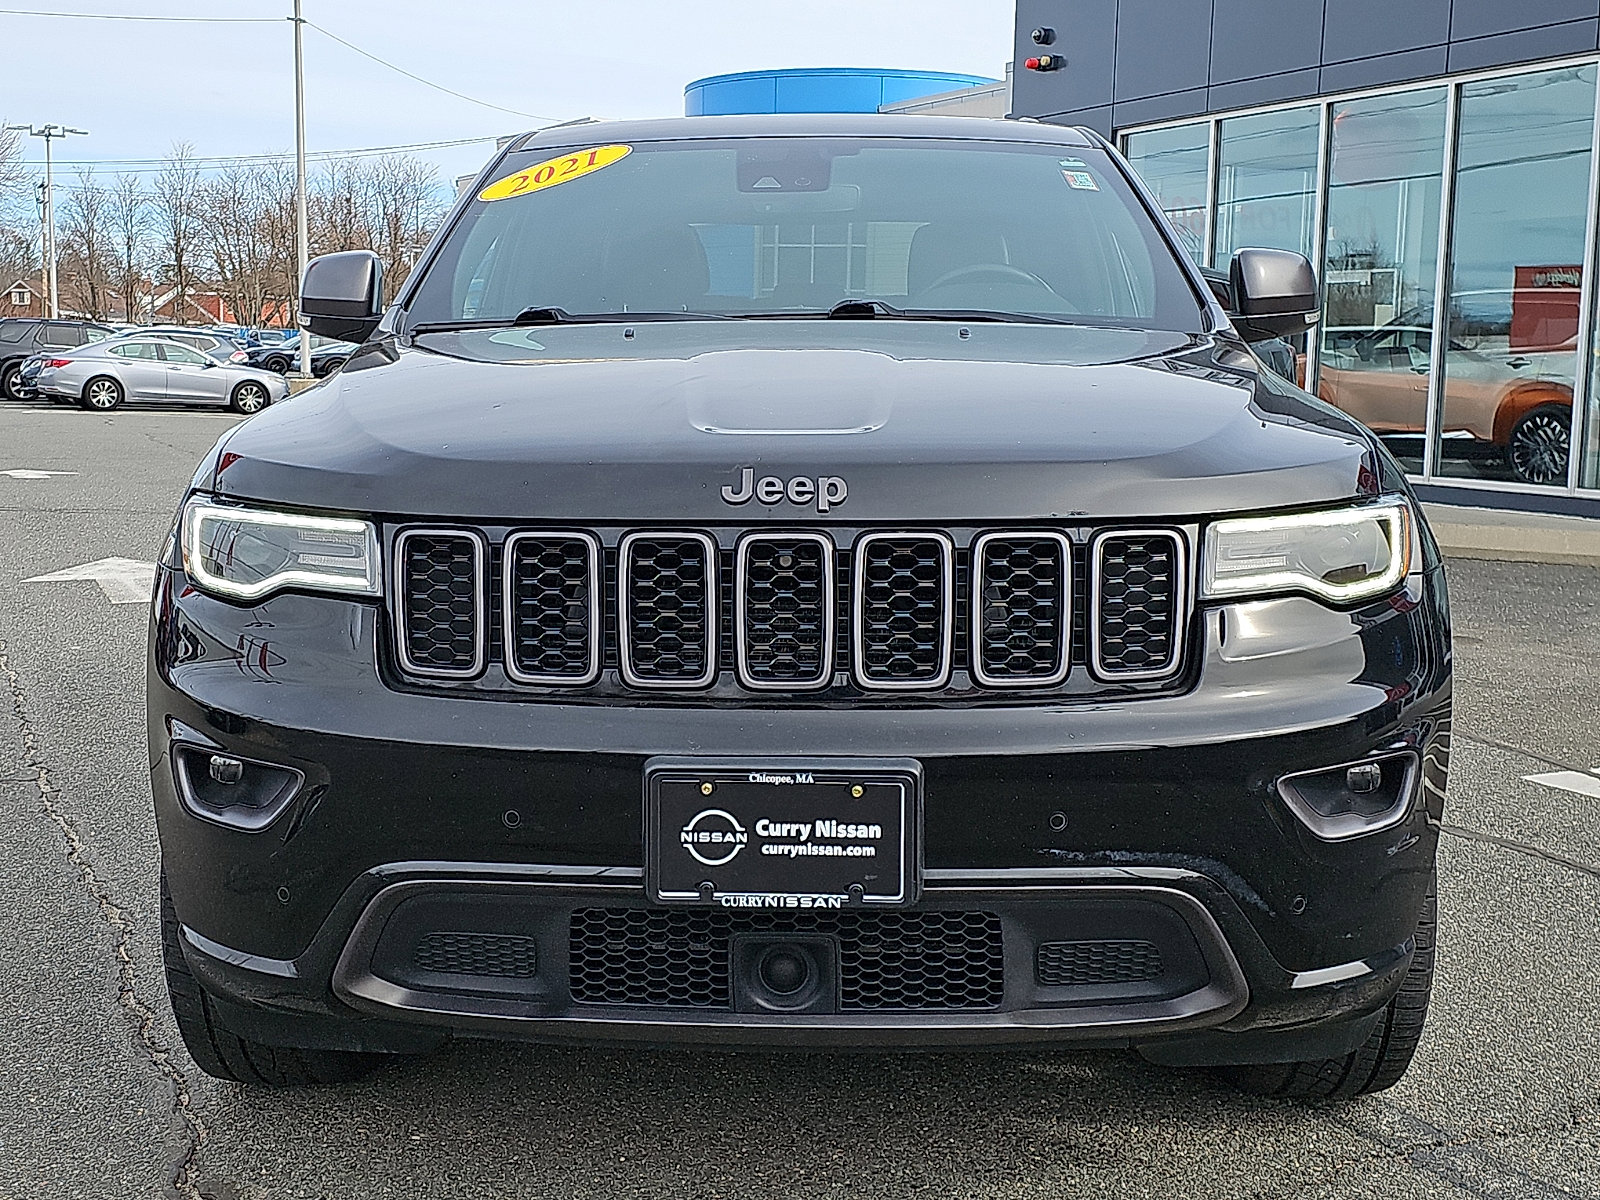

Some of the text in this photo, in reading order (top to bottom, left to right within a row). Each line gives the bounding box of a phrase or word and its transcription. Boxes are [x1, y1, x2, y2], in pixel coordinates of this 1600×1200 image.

[509, 150, 598, 194] 2021
[721, 467, 848, 514] Jeep
[749, 772, 814, 785] Chicopee, MA
[680, 831, 748, 843] NISSAN
[755, 819, 882, 841] Curry Nissan
[761, 842, 876, 858] currynissan.com
